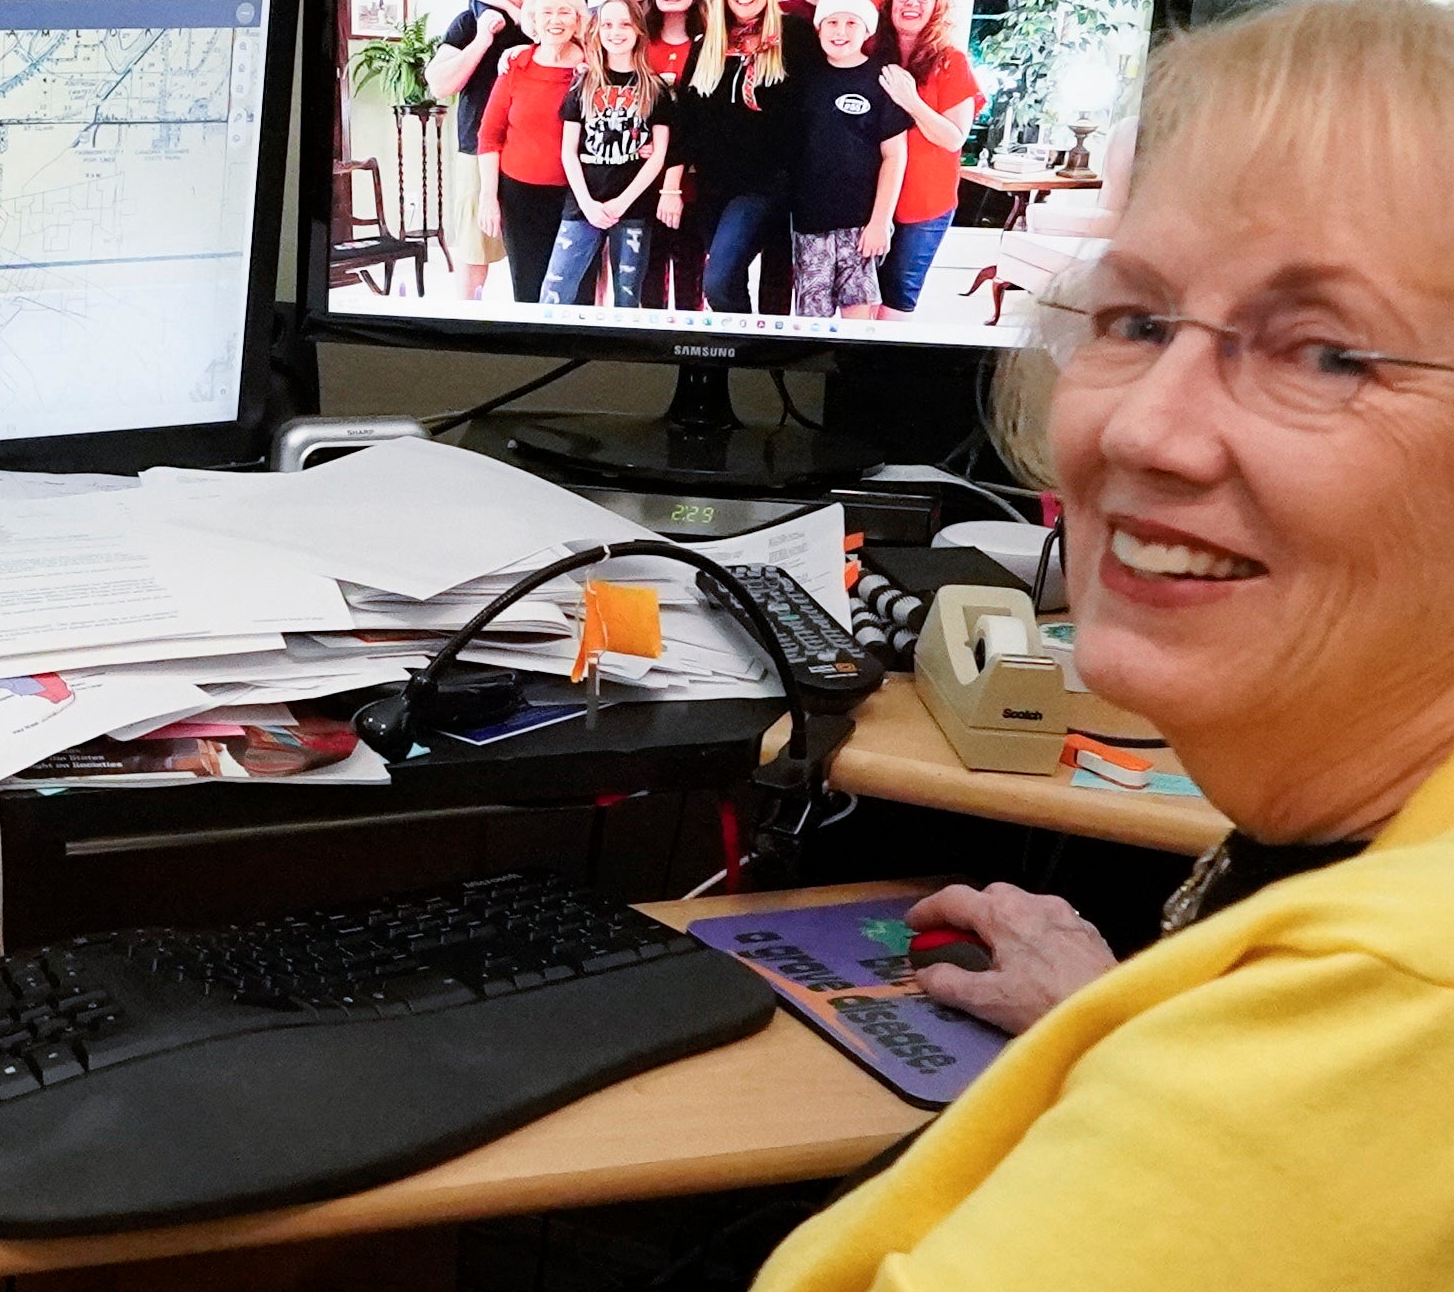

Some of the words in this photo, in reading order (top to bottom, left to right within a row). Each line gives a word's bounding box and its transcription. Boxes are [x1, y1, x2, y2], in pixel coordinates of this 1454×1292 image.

[673, 344, 736, 358] SAMSUNG
[671, 503, 715, 524] 2:29
[1002, 708, 1044, 722] Scotch
